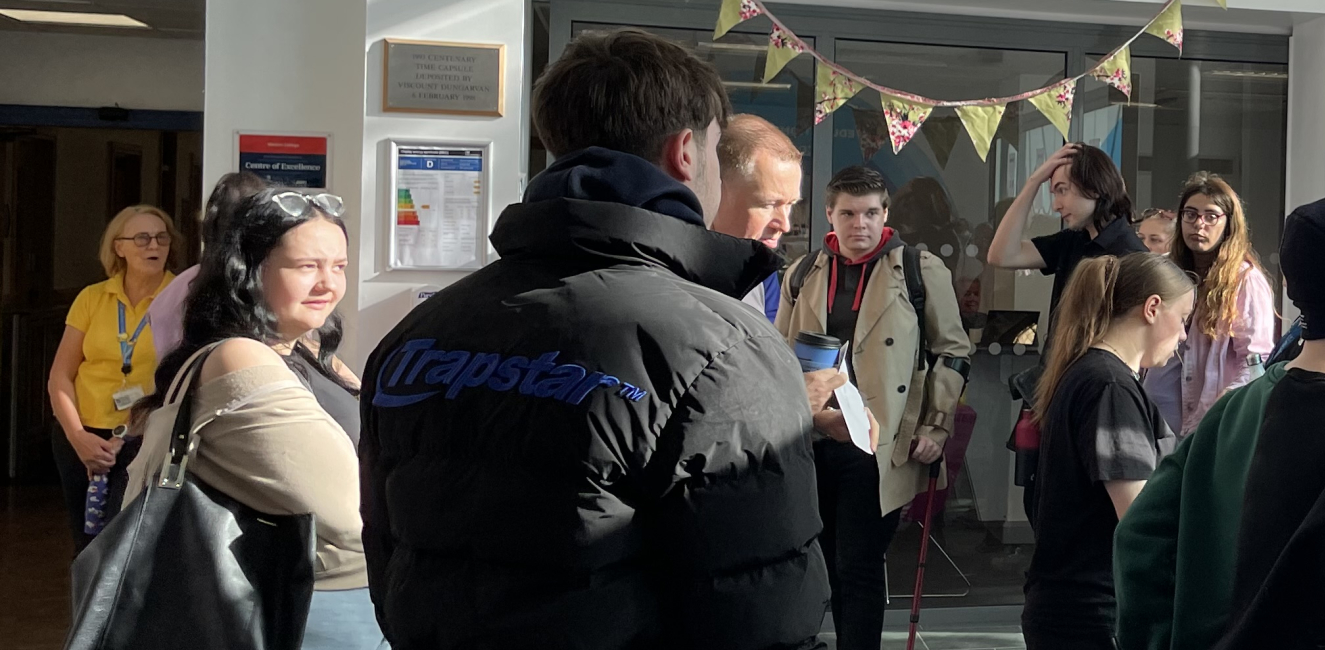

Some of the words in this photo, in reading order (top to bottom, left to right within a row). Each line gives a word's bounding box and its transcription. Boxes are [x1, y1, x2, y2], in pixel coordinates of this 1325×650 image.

[427, 54, 477, 63] CENTENARY
[415, 63, 436, 71] TIME
[438, 64, 474, 73] CAPSULE
[415, 72, 460, 82] DEPOSITED
[397, 81, 438, 90] VISCOUNT
[440, 83, 490, 92] DUNGARVAN
[418, 92, 460, 100] FEBRUARY
[245, 161, 270, 170] Centre
[271, 162, 281, 170] of
[281, 163, 321, 171] Excellence
[426, 160, 434, 168] D
[379, 338, 621, 406] Trapstar
